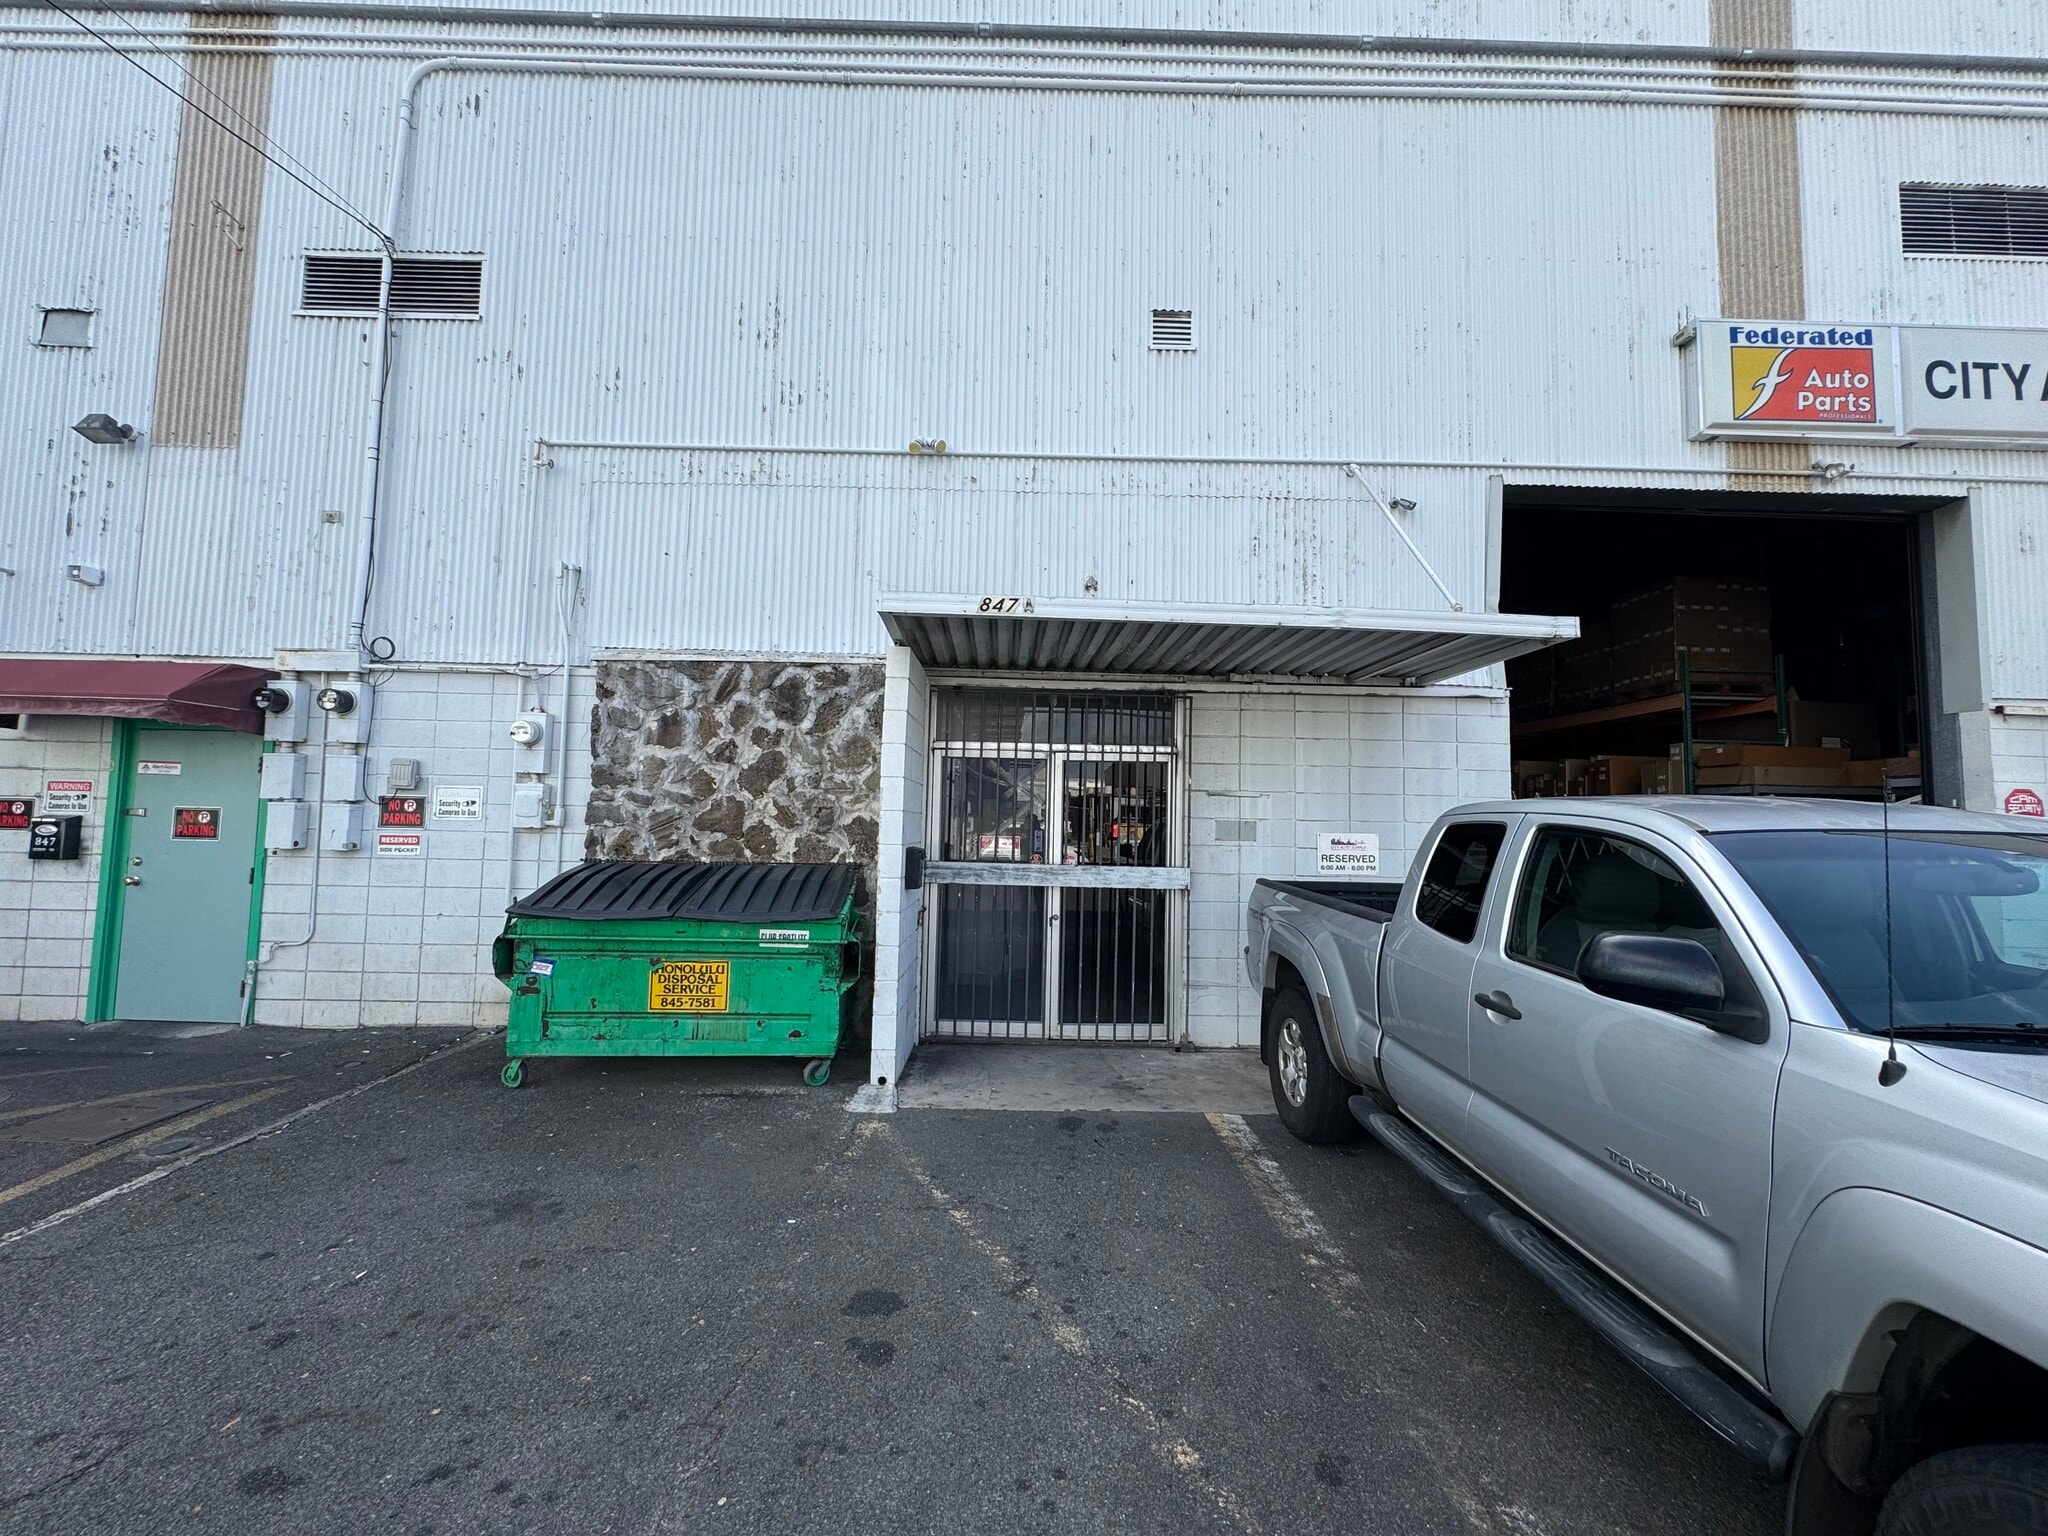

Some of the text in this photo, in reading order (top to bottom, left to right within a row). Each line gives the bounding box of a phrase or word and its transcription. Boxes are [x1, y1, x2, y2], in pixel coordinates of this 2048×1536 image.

[1729, 326, 1873, 346] Federated
[1803, 367, 1870, 389] Auto
[1925, 360, 2031, 400] CITY
[1797, 391, 1872, 412] Parts
[979, 597, 1019, 613] 847
[49, 782, 91, 792] WARNING
[49, 793, 72, 802] Security
[48, 803, 71, 811] Cameras
[388, 800, 400, 811] NO
[438, 799, 461, 808] Security
[2008, 803, 2042, 815] SECURITY
[182, 811, 194, 823] NO
[438, 808, 460, 816] Cameras
[383, 813, 421, 825] PARKING
[177, 825, 215, 836] PARKING
[34, 837, 57, 847] 847
[380, 836, 418, 844] RESERVED
[1321, 854, 1376, 863] RESERVED
[658, 974, 723, 984] DISPOSAL
[663, 984, 716, 994] SERVICE
[660, 997, 716, 1008] 845-7581
[1604, 1145, 1710, 1217] TACOMA
